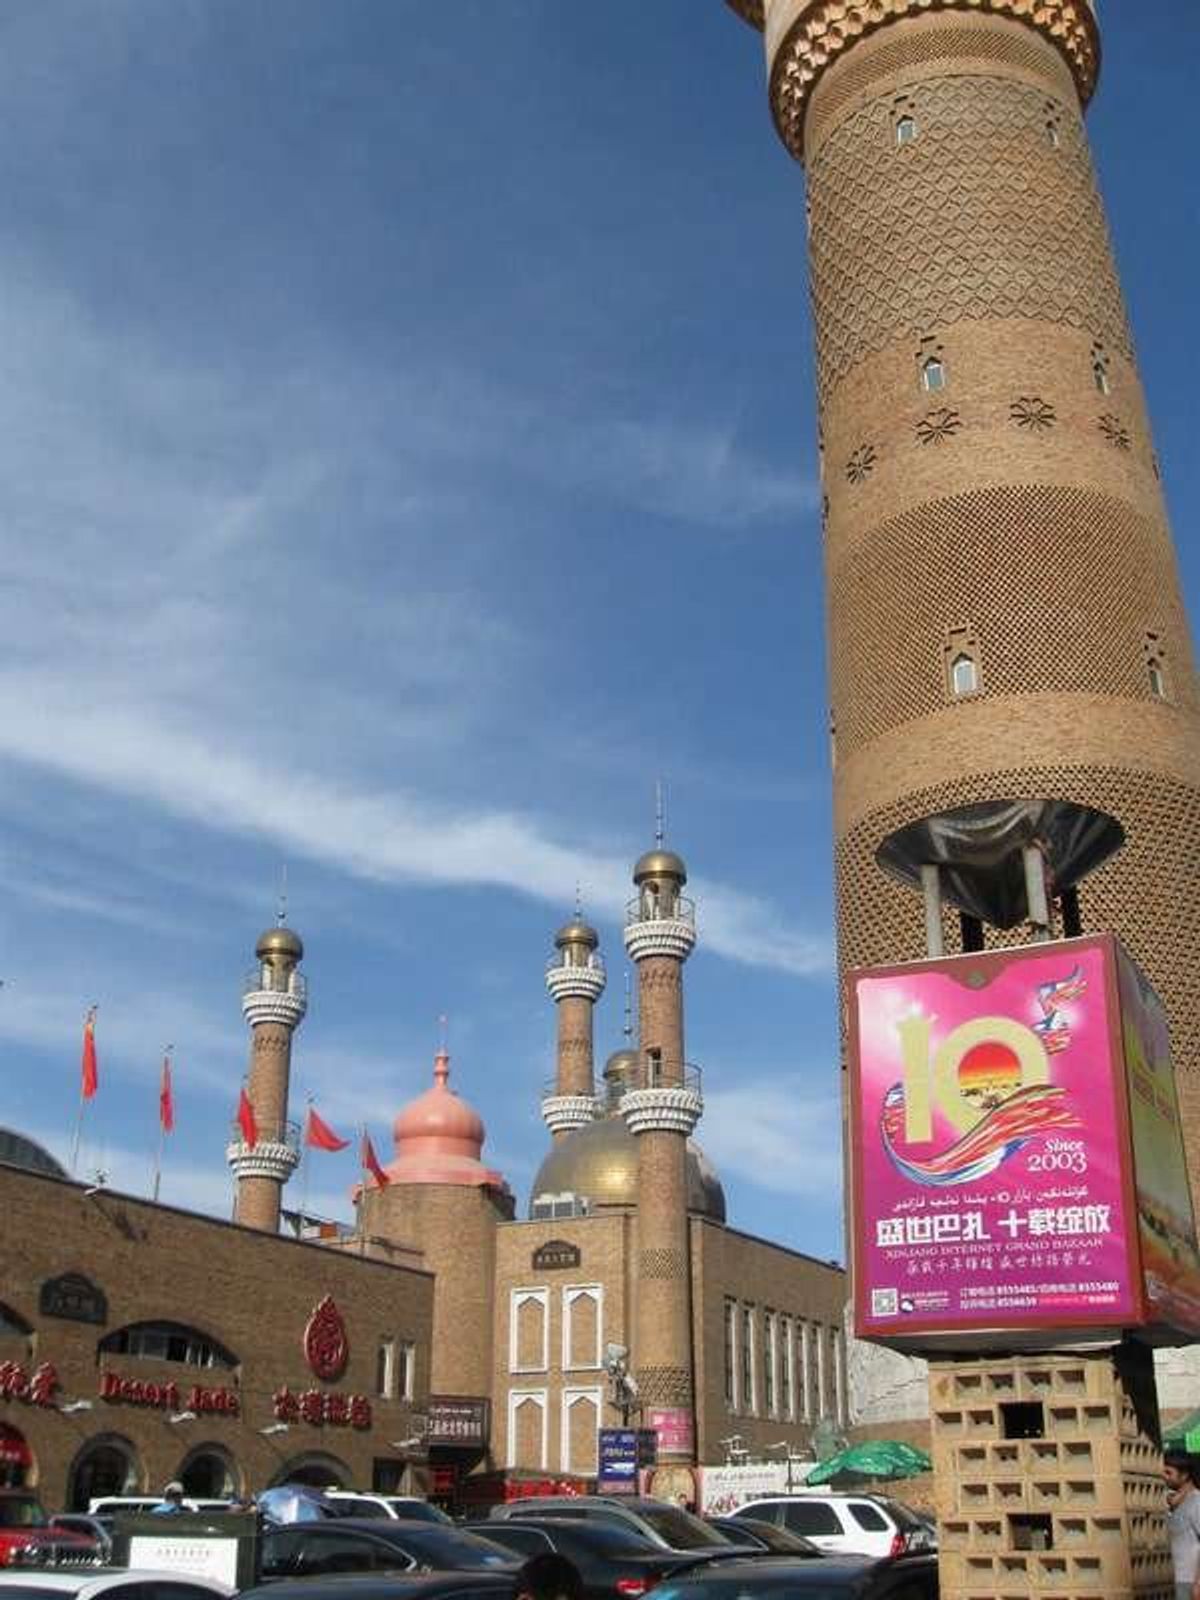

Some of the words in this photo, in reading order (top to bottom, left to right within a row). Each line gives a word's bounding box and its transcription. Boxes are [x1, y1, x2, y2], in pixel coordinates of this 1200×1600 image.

[1027, 1151, 1088, 1174] 2003
[876, 1211, 992, 1247] 盛世巴扎
[997, 1203, 1111, 1238] 十载绽放
